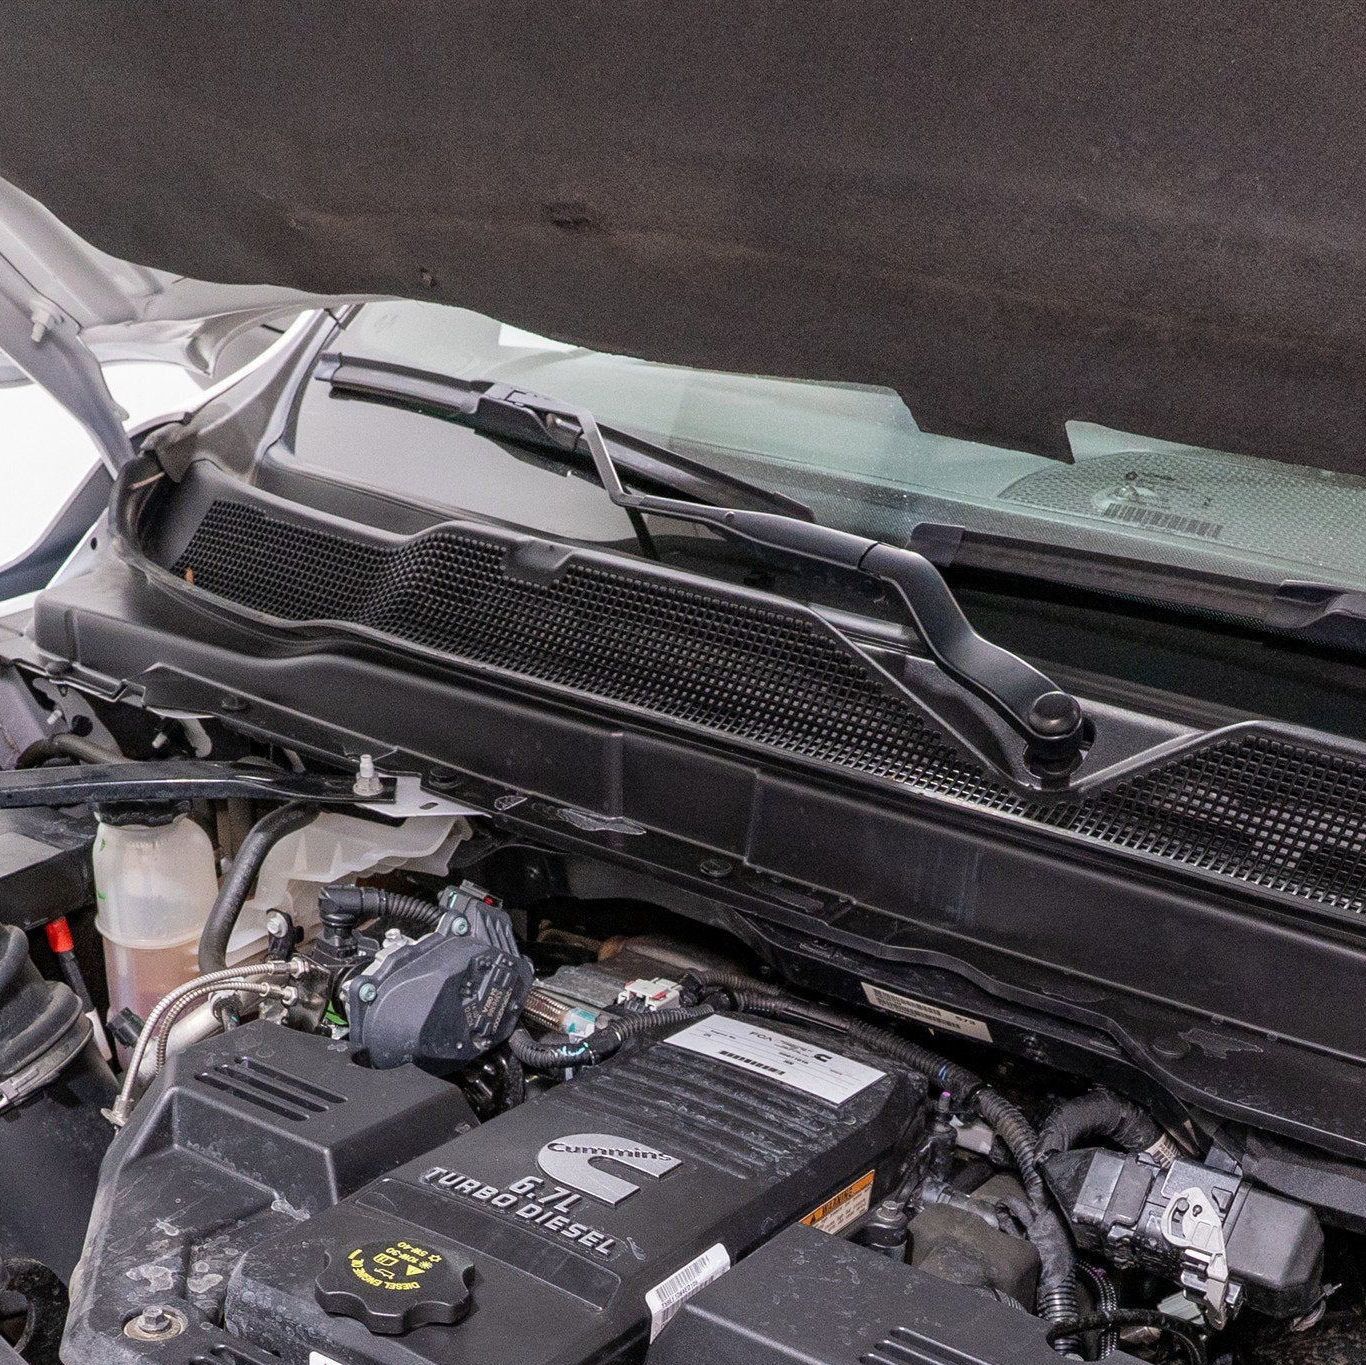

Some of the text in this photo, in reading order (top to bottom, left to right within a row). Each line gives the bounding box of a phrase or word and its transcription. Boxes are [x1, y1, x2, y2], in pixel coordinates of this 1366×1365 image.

[546, 1142, 673, 1162] Cummins
[508, 1175, 583, 1214] 6.7L
[423, 1166, 617, 1256] TURBO DIESEL
[385, 1247, 420, 1264] 10W-30
[397, 1241, 429, 1256] 5W-40
[384, 1281, 421, 1291] DIESEL
